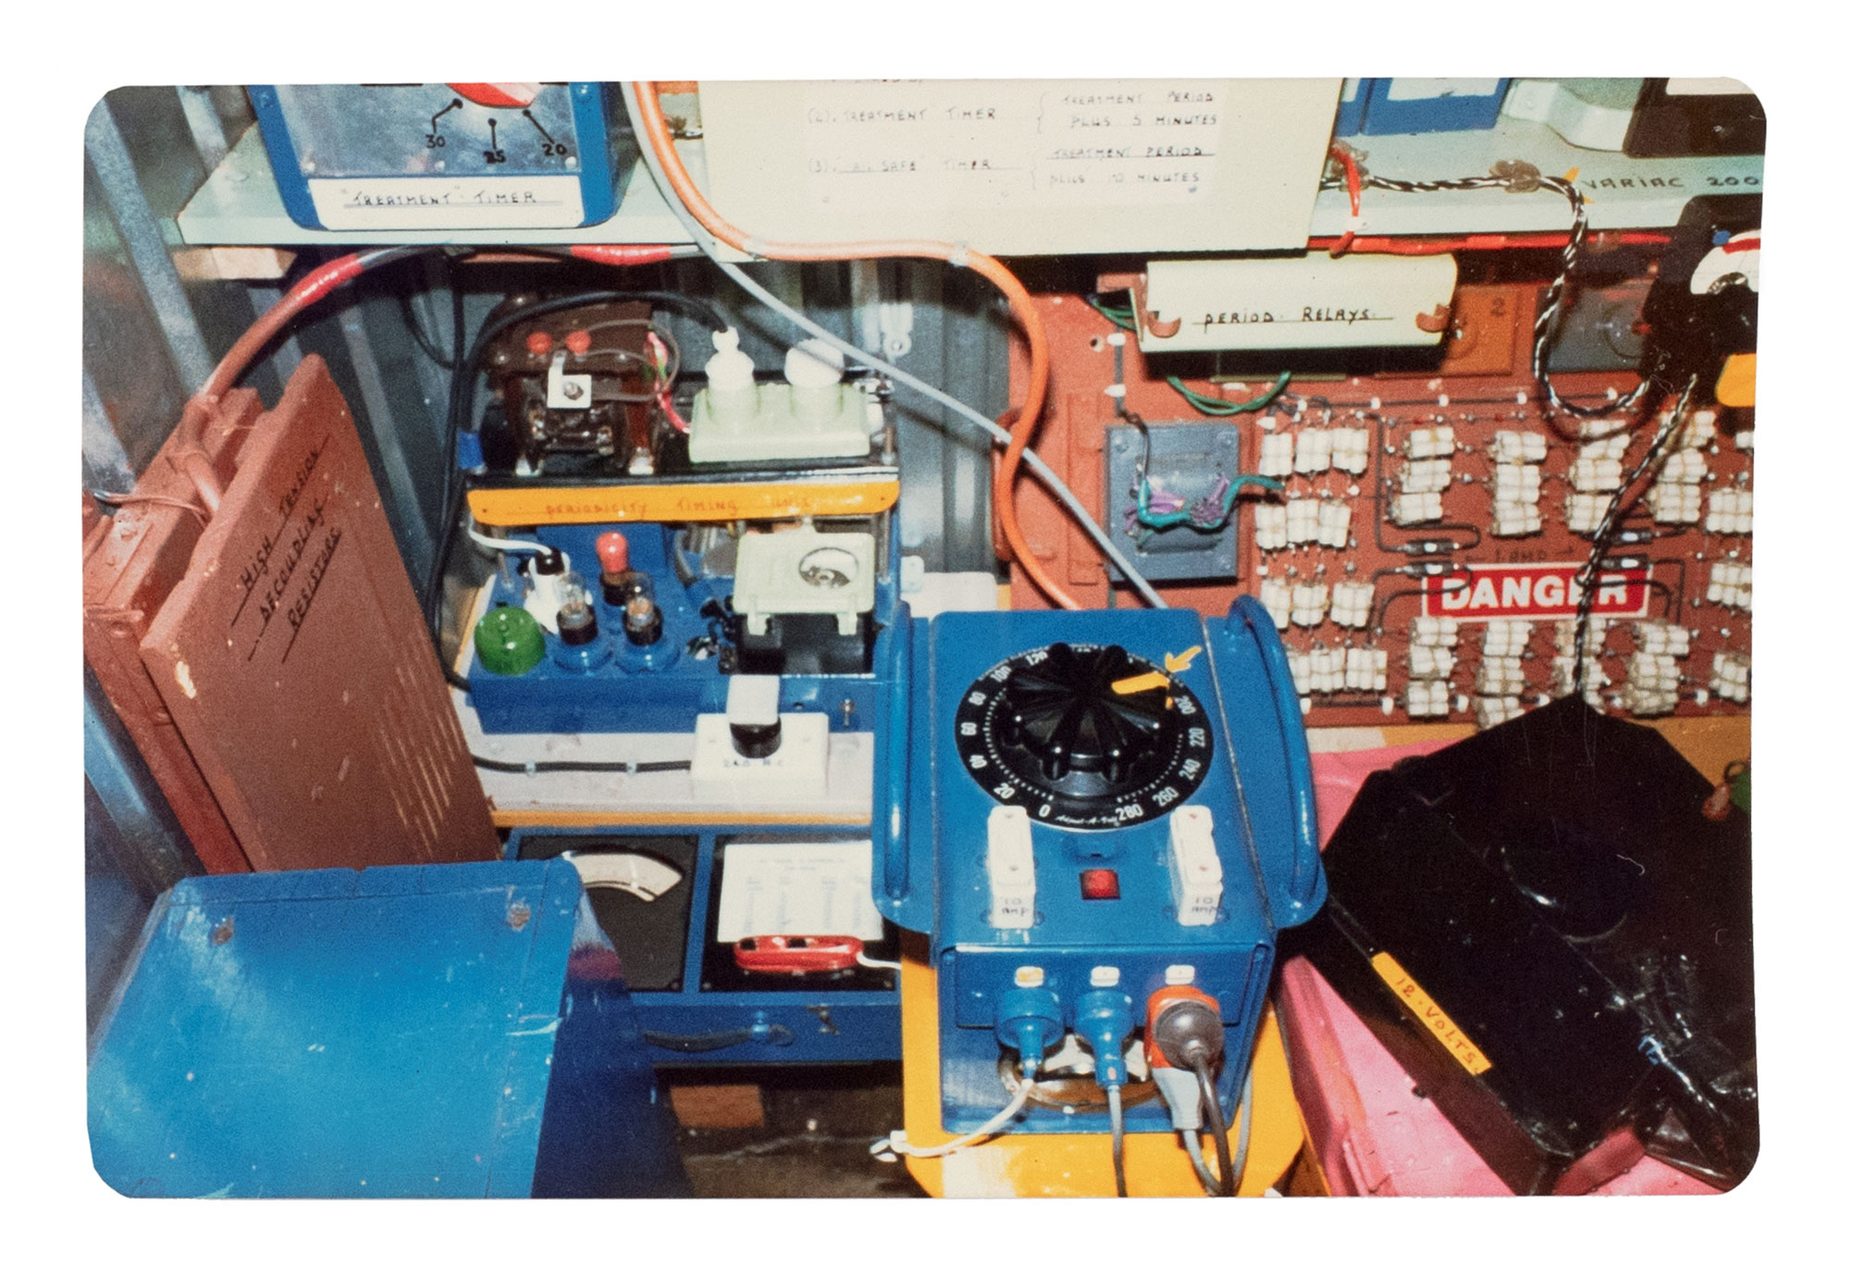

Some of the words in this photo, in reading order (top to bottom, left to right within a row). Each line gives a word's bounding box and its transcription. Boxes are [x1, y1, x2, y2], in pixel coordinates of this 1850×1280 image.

[843, 108, 928, 121] TREATMENT
[945, 106, 997, 121] TIMER
[1071, 115, 1111, 128] PLUS
[1155, 114, 1217, 126] MINUTES
[425, 134, 447, 149] 30
[541, 142, 567, 157] 20
[1054, 145, 1132, 158] TREATMENT
[1146, 145, 1203, 157] PERIOD
[483, 150, 506, 165] 25
[1582, 175, 1684, 190] VARIAC
[1705, 175, 1760, 188] 200
[473, 190, 537, 205] TIMER
[1188, 727, 1206, 748] 220
[1178, 758, 1201, 780] 240
[993, 782, 1016, 799] 20
[1151, 786, 1180, 807] 260
[1038, 804, 1051, 818] 0
[1115, 803, 1144, 821] 280
